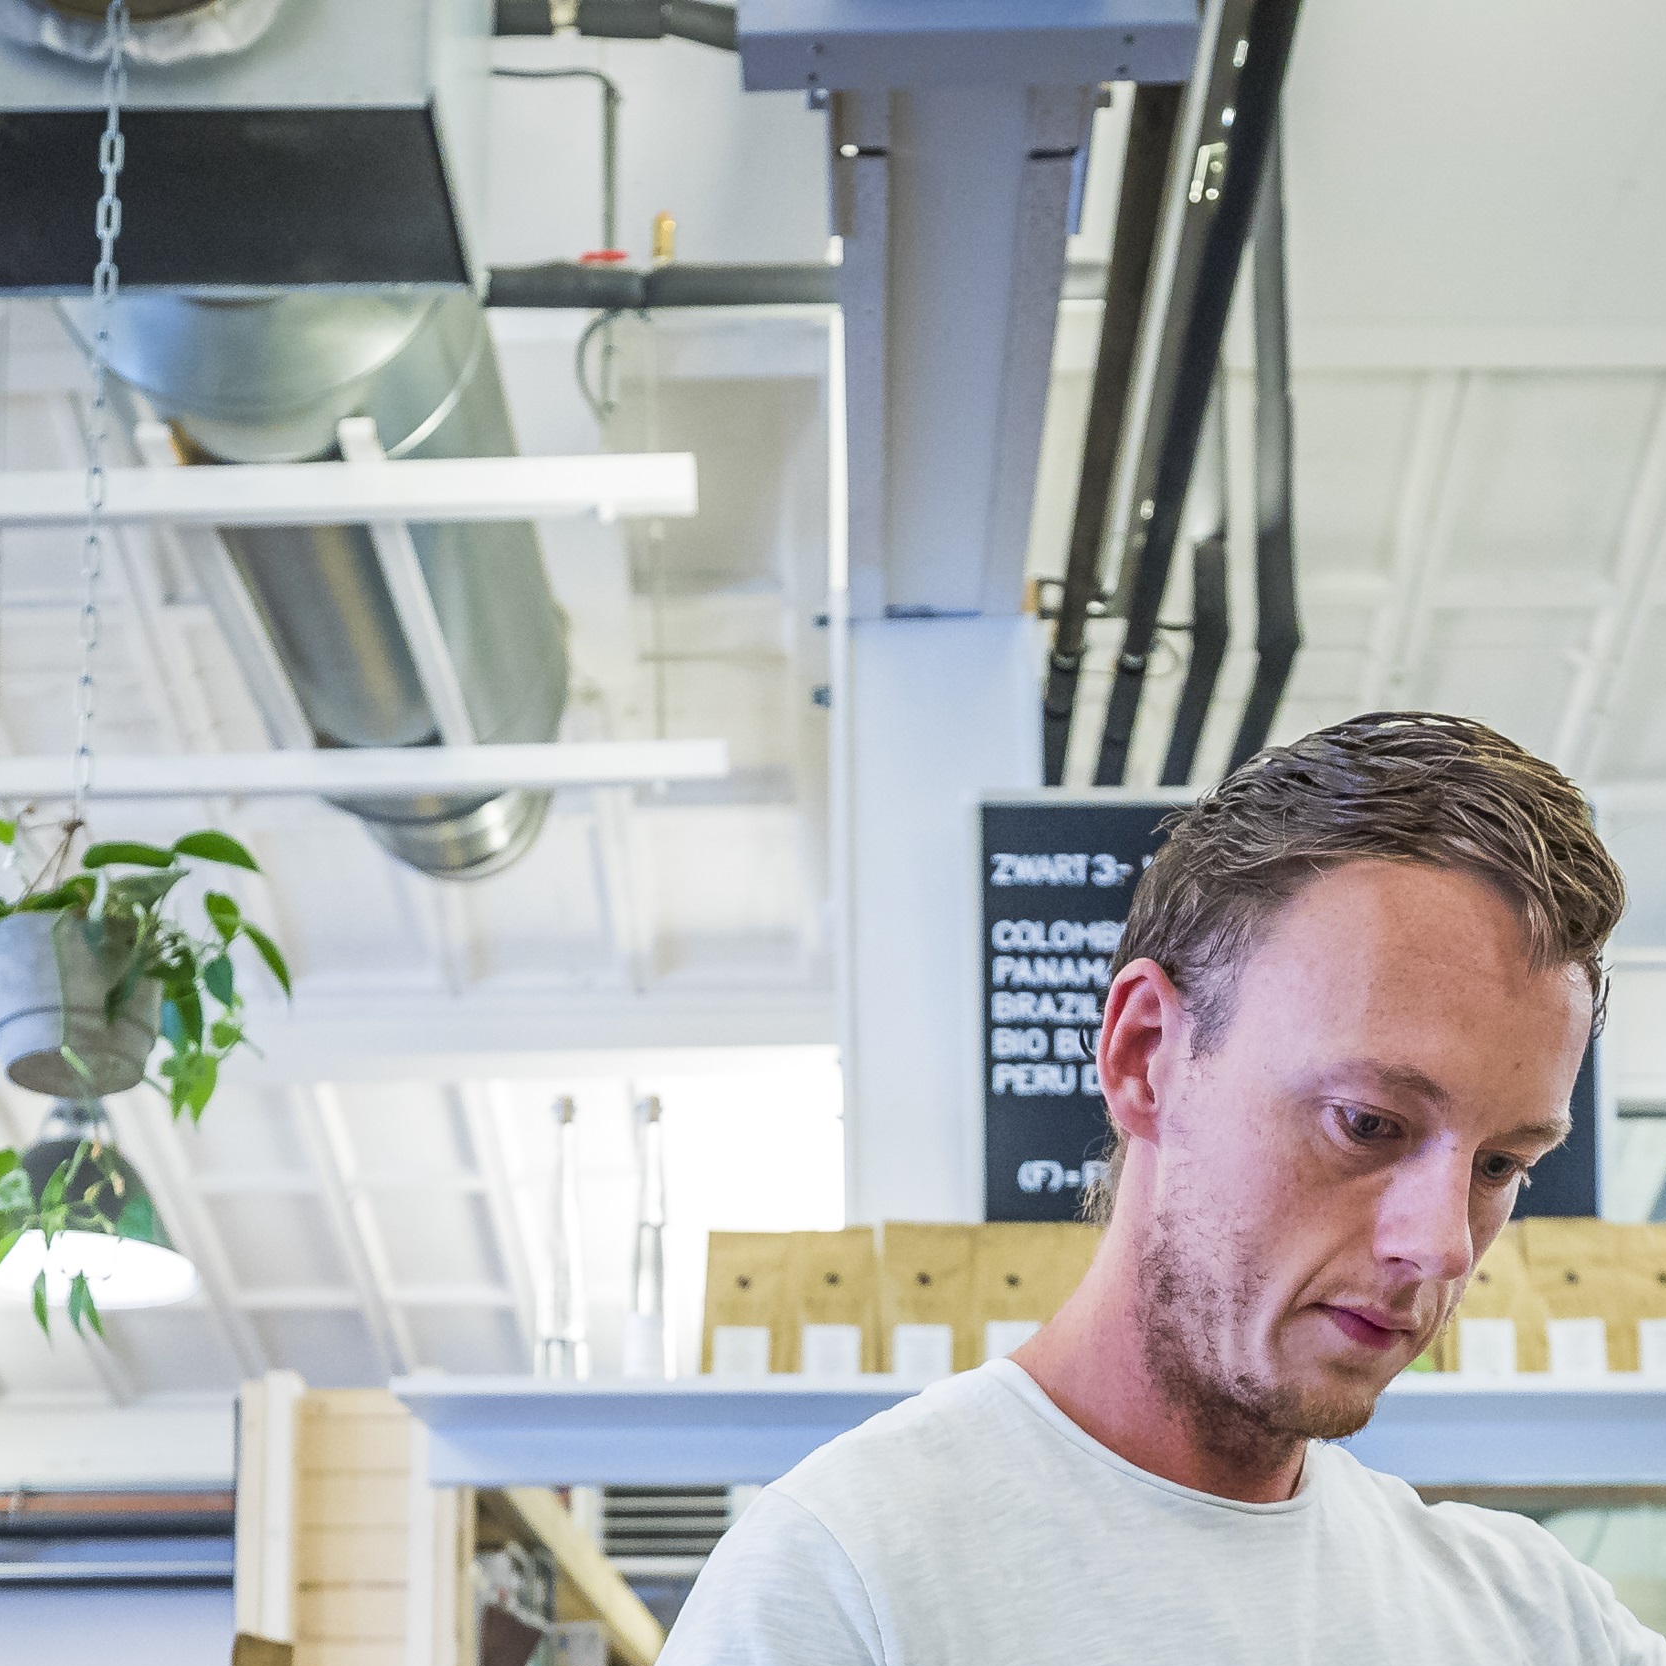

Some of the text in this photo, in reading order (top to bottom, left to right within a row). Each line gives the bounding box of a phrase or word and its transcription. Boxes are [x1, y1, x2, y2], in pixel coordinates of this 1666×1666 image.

[990, 853, 1090, 886] ZWART
[992, 919, 1127, 952] COLOMB
[992, 956, 1112, 988] PANAM
[991, 991, 1103, 1024] BRAZIL
[991, 1027, 1049, 1060] BIO
[992, 1063, 1078, 1096] PERU
